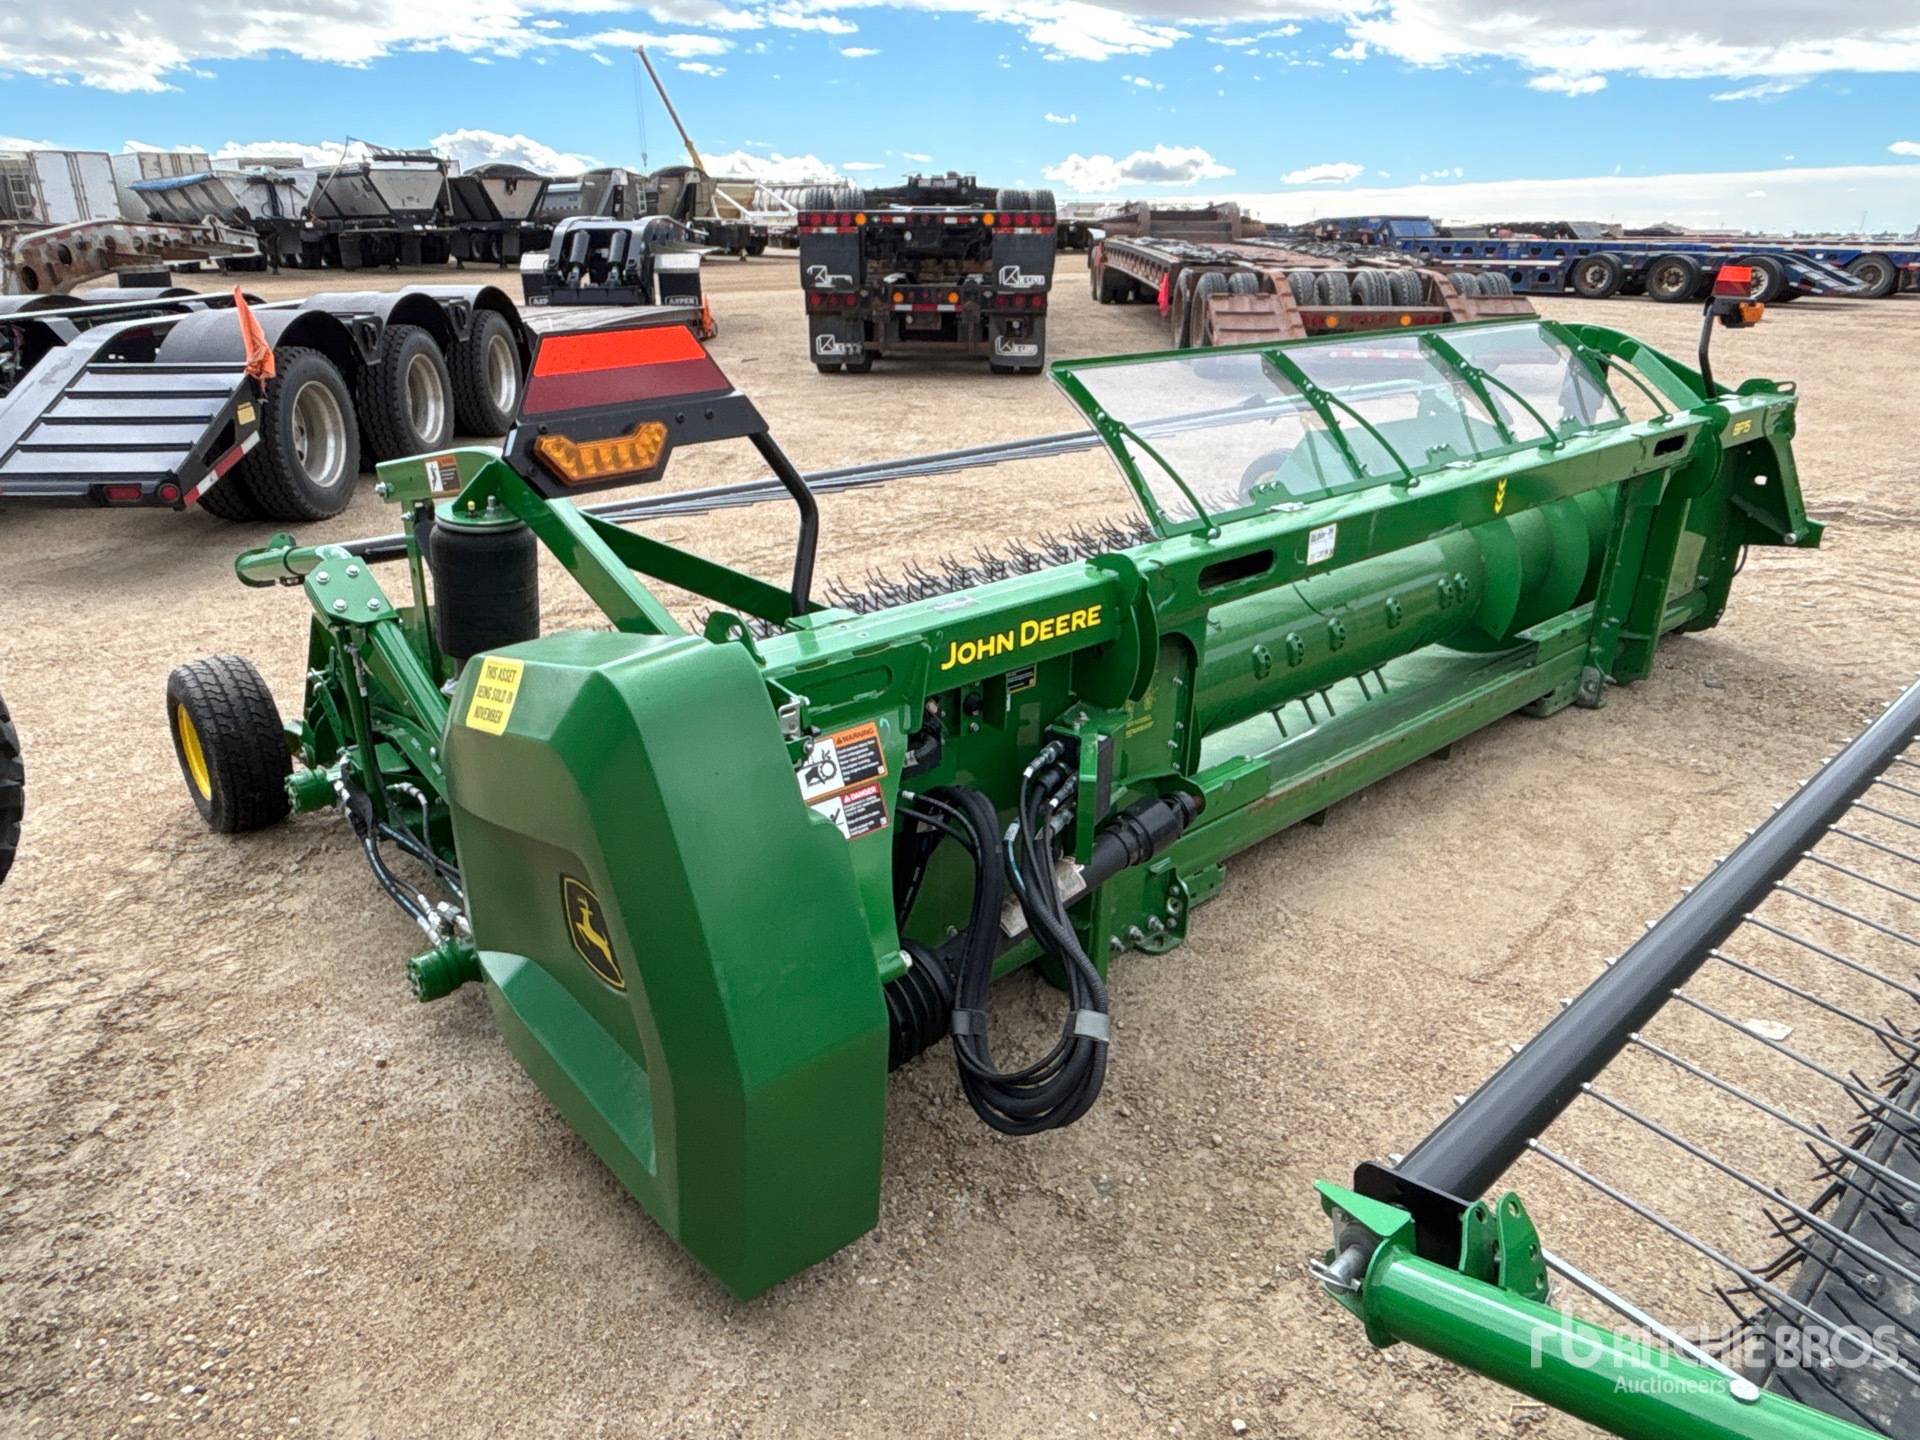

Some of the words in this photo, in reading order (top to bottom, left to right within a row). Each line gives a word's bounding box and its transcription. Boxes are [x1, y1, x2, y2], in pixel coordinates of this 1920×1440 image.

[669, 297, 695, 305] ASPEN
[941, 630, 1014, 671] JOHN
[1020, 604, 1102, 647] DEERE
[486, 665, 499, 680] THIS
[497, 668, 518, 683] ASSET
[476, 685, 493, 700] BEING
[491, 687, 507, 703] SOLD
[506, 691, 514, 704] IN
[473, 705, 504, 724] NOVEMBER
[842, 727, 875, 742] WARNING
[850, 785, 878, 800] DANGER
